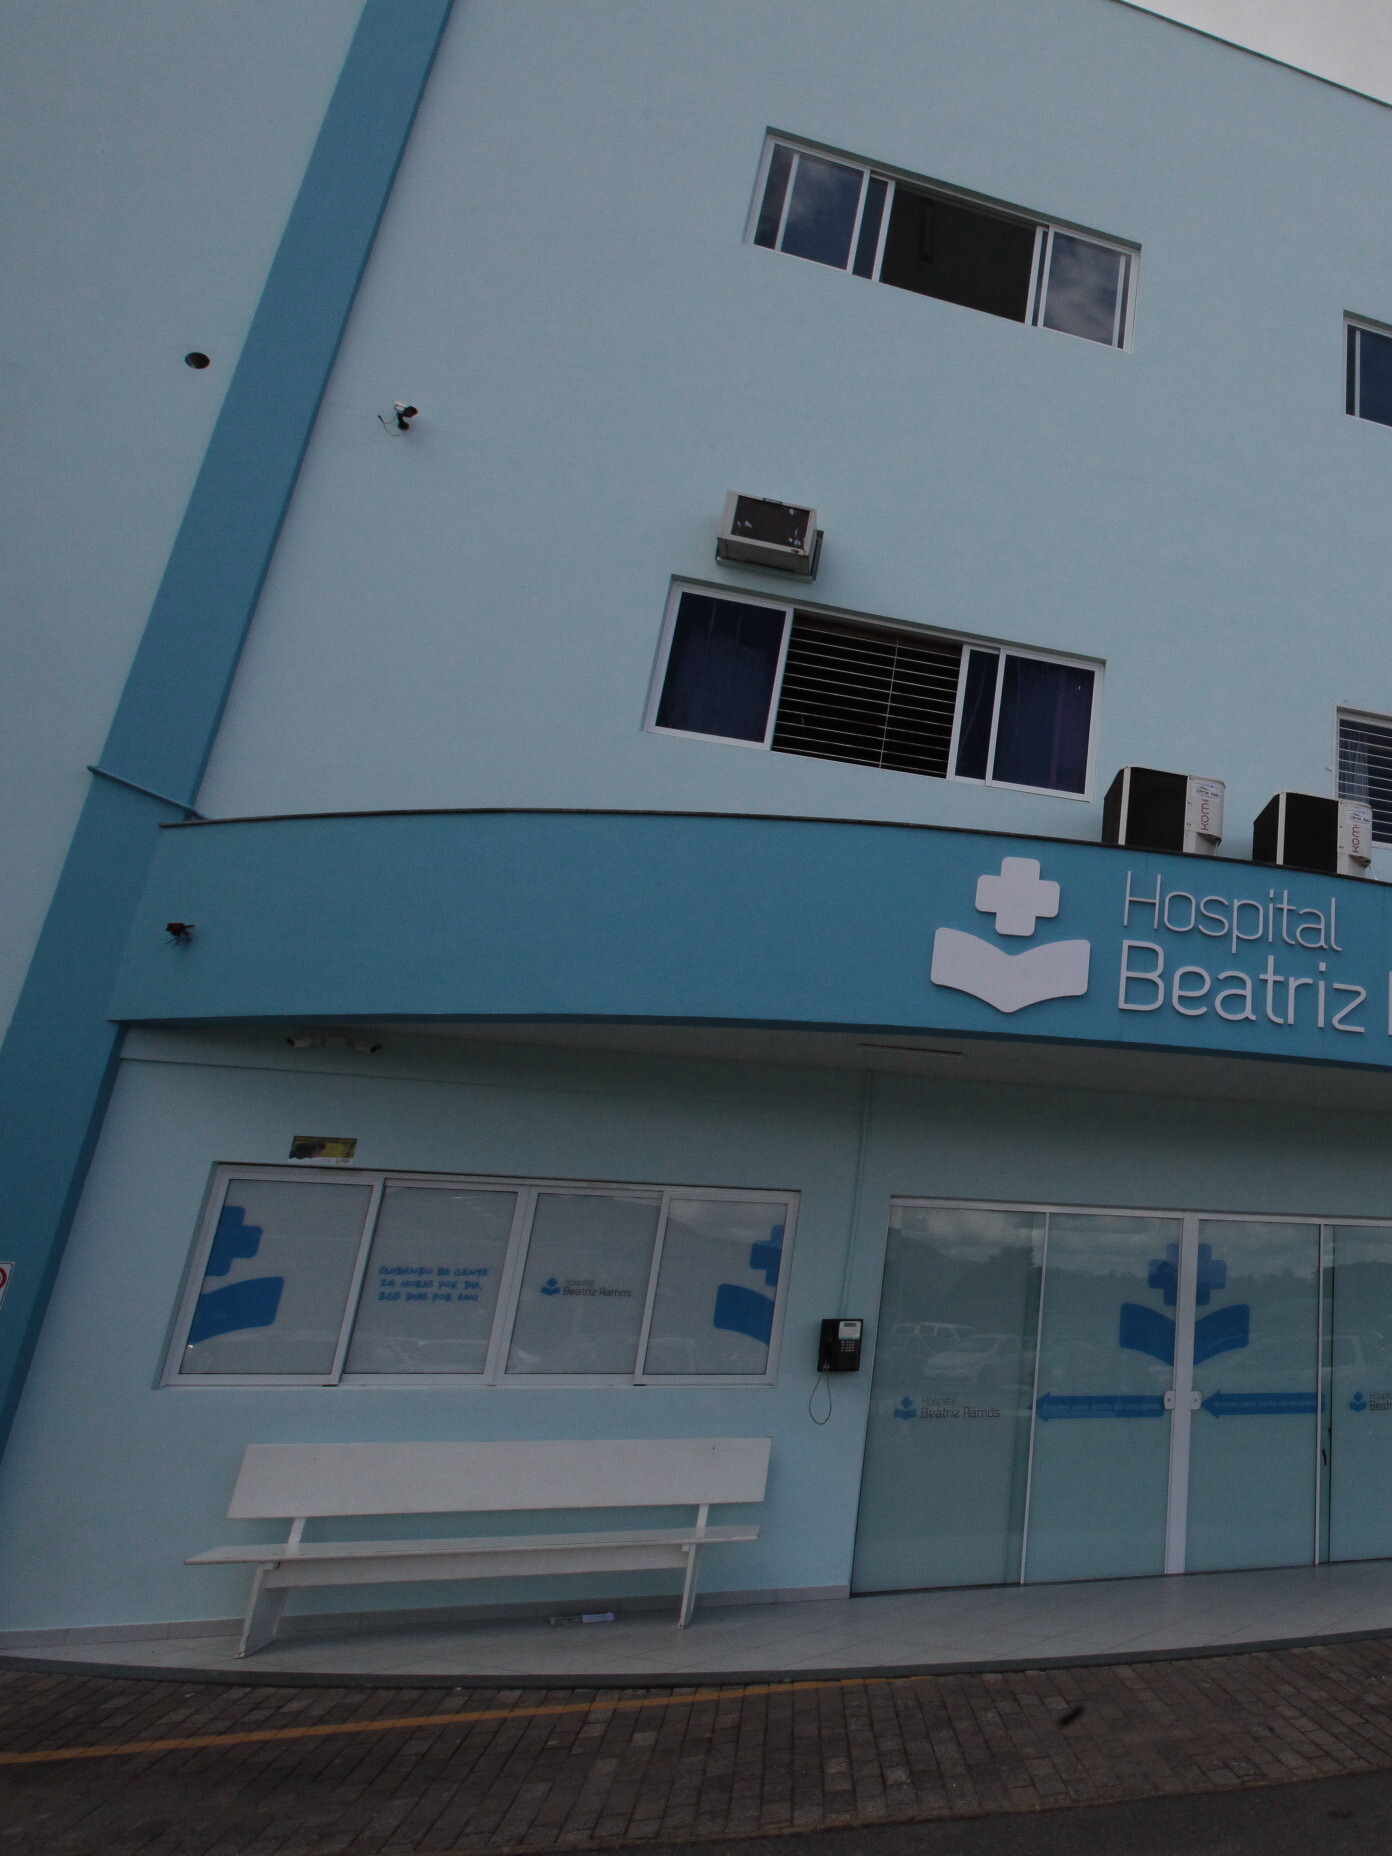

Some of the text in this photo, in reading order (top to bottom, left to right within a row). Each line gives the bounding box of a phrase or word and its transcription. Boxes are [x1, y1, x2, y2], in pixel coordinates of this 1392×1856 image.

[1124, 871, 1342, 954] Hospital
[1118, 939, 1367, 1033] Beatriz
[378, 1292, 401, 1301] 365
[563, 1286, 631, 1297] Beatriz Ramos
[920, 1406, 1001, 1418] Beatriz Ramos
